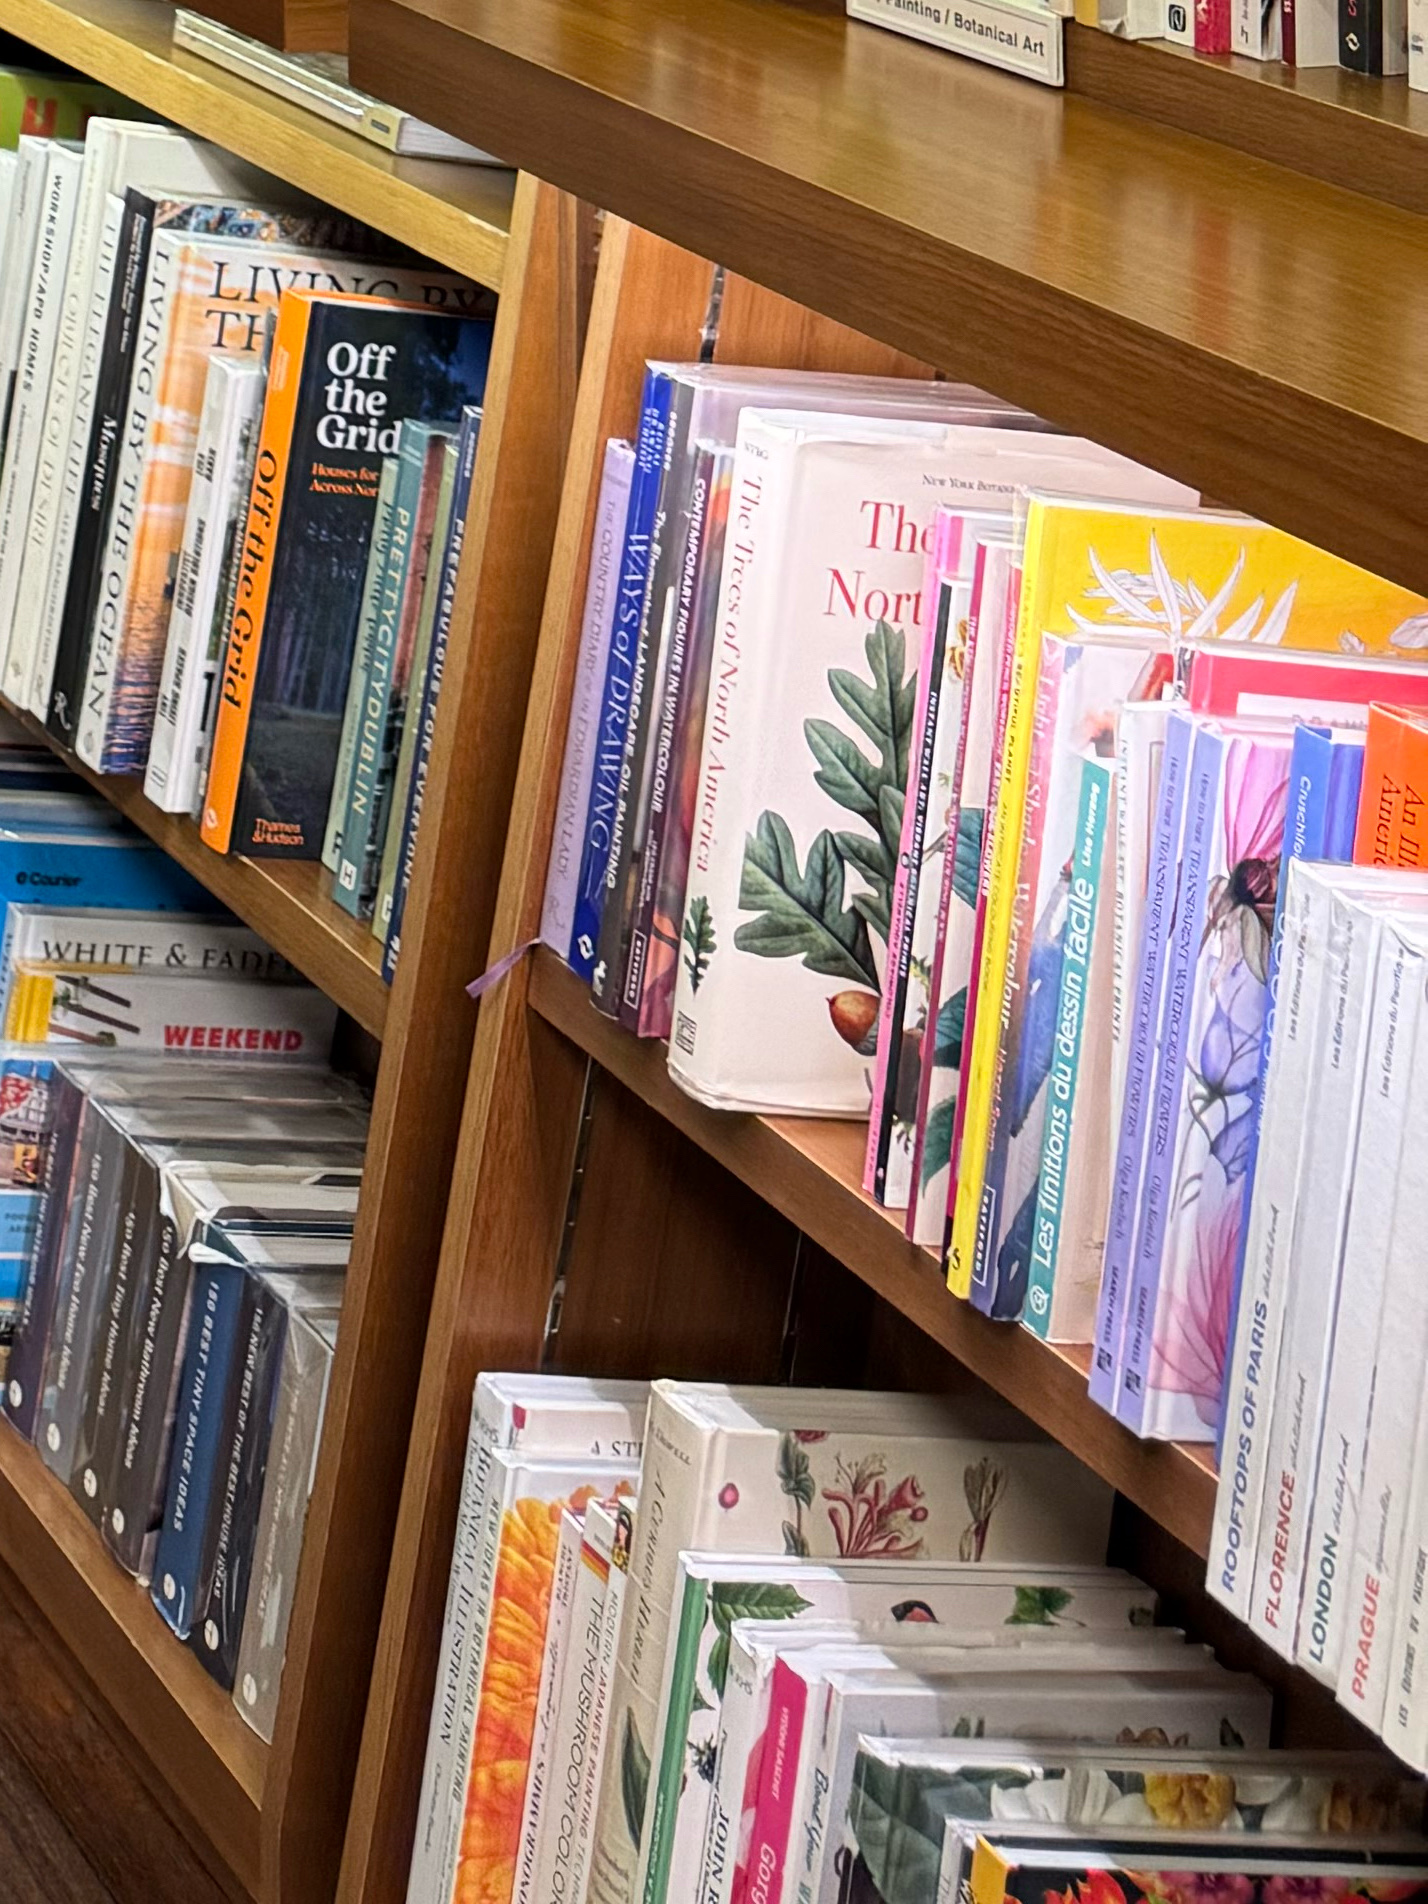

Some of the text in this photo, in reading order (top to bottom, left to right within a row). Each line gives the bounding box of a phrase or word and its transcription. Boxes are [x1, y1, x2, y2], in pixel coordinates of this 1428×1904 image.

[955, 12, 1018, 47] Botanical
[1023, 35, 1045, 57] Art
[24, 329, 42, 392] HOMES
[326, 341, 398, 381] Off
[325, 377, 389, 417] the
[91, 414, 118, 512] Mosques
[316, 414, 402, 455] Grid
[86, 250, 171, 719] LIVING BY THE OCEAN
[308, 478, 353, 495] Across
[311, 463, 381, 482] Houses for
[861, 499, 936, 556] The
[223, 449, 278, 709] Off the Grid
[352, 507, 412, 816] PRETTYCITYDUBLIN
[695, 474, 764, 874] The Trees of North America
[589, 532, 649, 859] WAYS of DRAWING
[254, 817, 302, 834] Thames
[43, 940, 187, 968] WHITE &
[163, 1024, 303, 1052] WEEKEND
[1036, 877, 1096, 1270] Les finitions du dessin facile
[1246, 1300, 1270, 1380] PARIS
[1242, 1385, 1261, 1430] OF
[1222, 1434, 1254, 1594] ROOFTOPS
[568, 1596, 607, 1773] THE MUSHROOM
[578, 1590, 620, 1839] MODERN JAPANESE PAINTING
